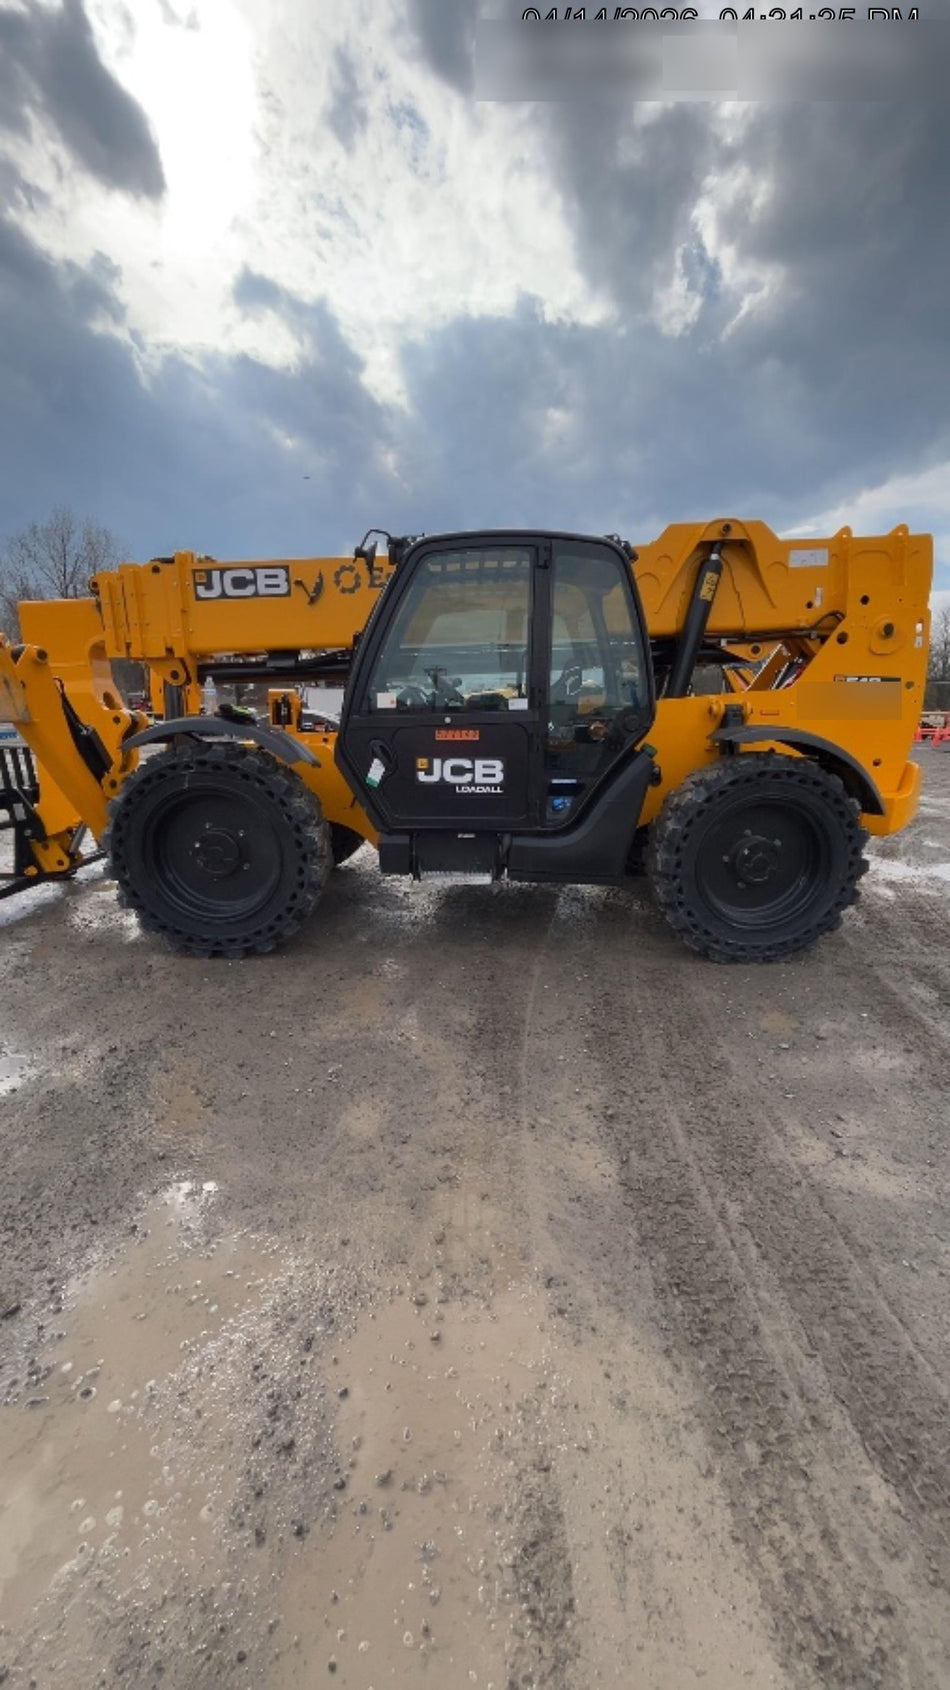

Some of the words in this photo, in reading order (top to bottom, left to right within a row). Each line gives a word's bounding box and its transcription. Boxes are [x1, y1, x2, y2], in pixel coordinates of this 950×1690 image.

[196, 567, 289, 598] JCB
[417, 758, 504, 784] JCB
[455, 785, 504, 794] LOADALL
